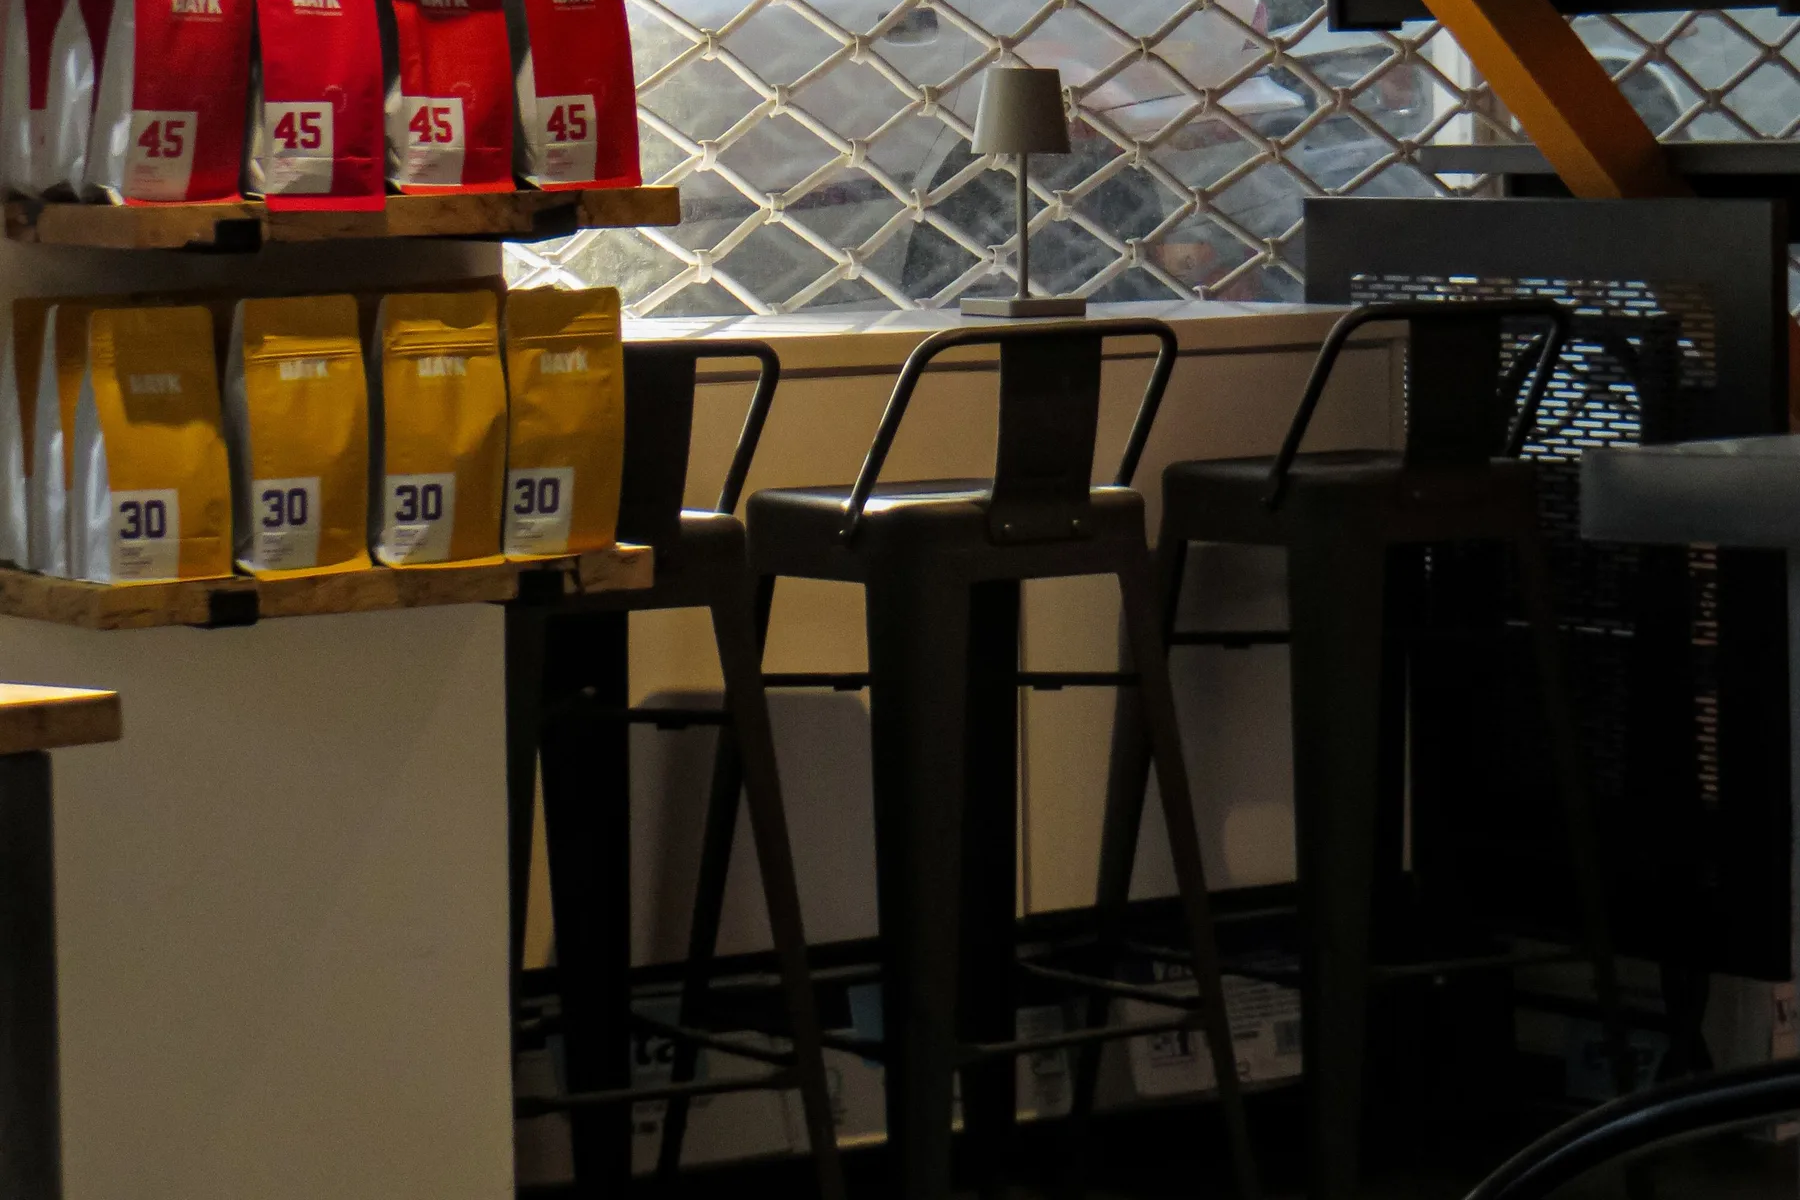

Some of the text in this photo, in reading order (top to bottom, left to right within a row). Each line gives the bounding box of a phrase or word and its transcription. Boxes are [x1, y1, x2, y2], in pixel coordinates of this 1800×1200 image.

[137, 120, 186, 158] 45
[274, 111, 322, 149] 45
[408, 105, 454, 143] 45
[546, 104, 588, 141] 45
[261, 487, 308, 527] 30
[395, 483, 443, 521] 30
[513, 477, 561, 515] 30
[119, 500, 167, 539] 30
